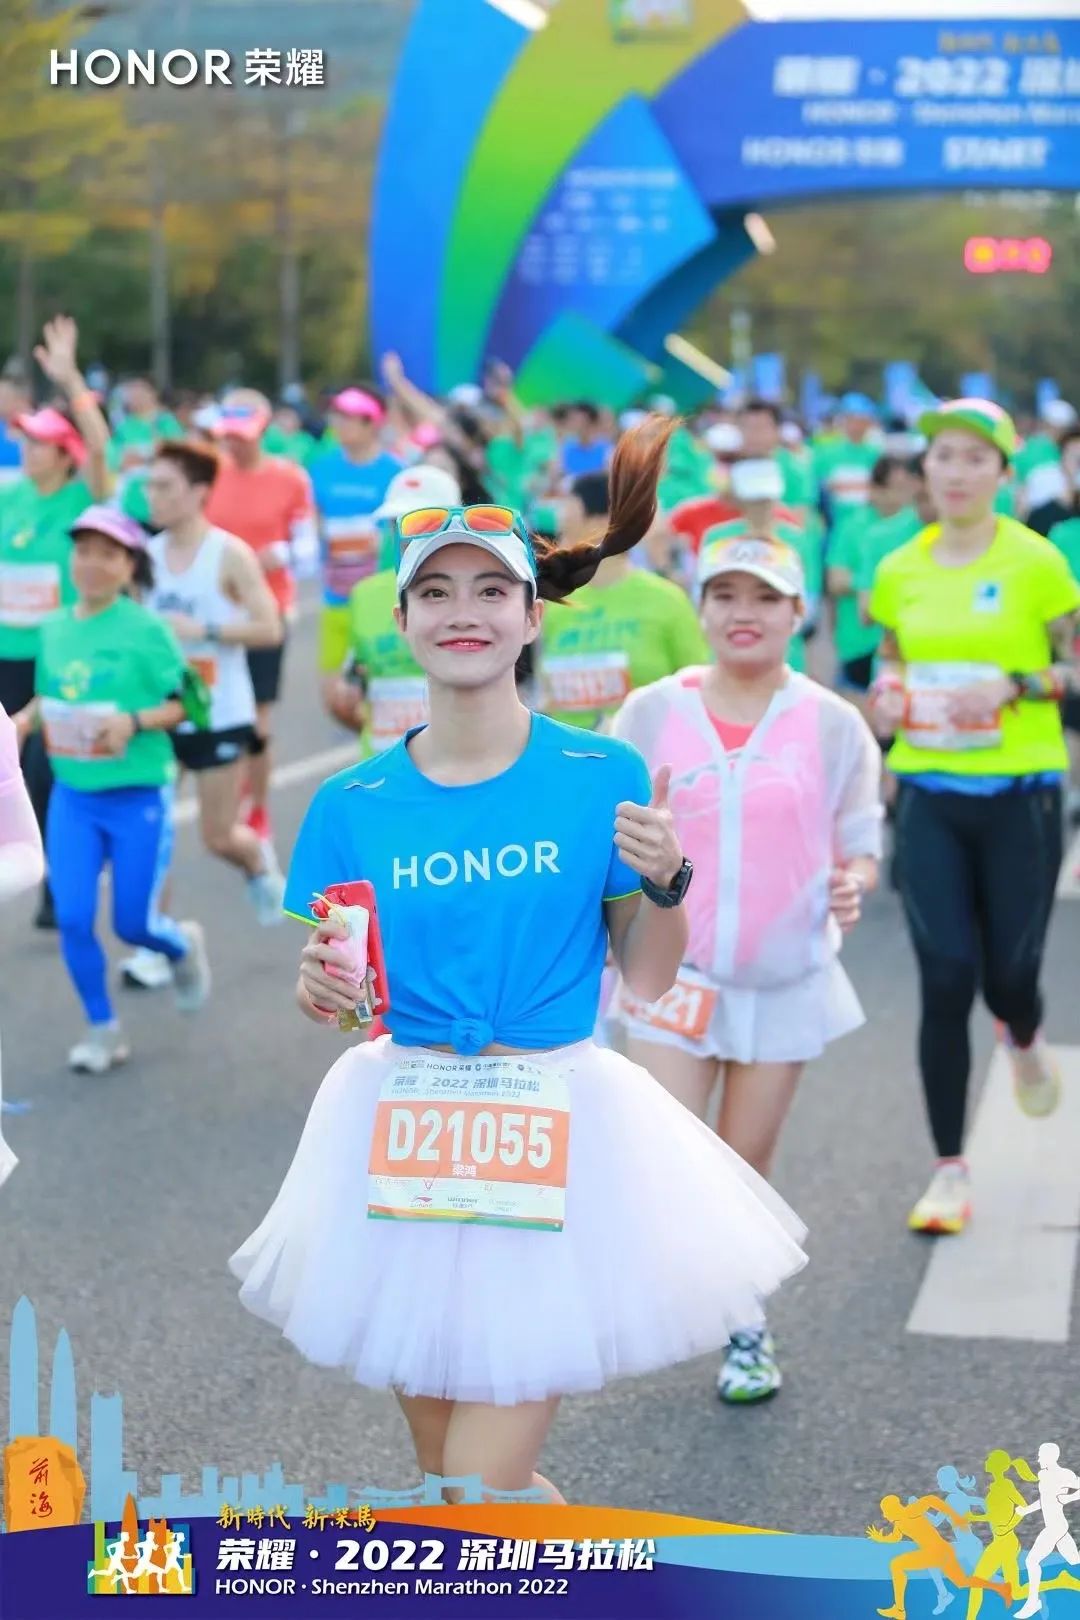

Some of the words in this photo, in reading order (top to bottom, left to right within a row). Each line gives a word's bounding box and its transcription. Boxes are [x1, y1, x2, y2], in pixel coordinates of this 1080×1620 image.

[393, 840, 560, 889] HONOR
[427, 1063, 457, 1072] HONOR
[432, 1077, 469, 1089] 2022
[473, 1078, 540, 1092] 深圳马拉松
[387, 1108, 553, 1169] D21055
